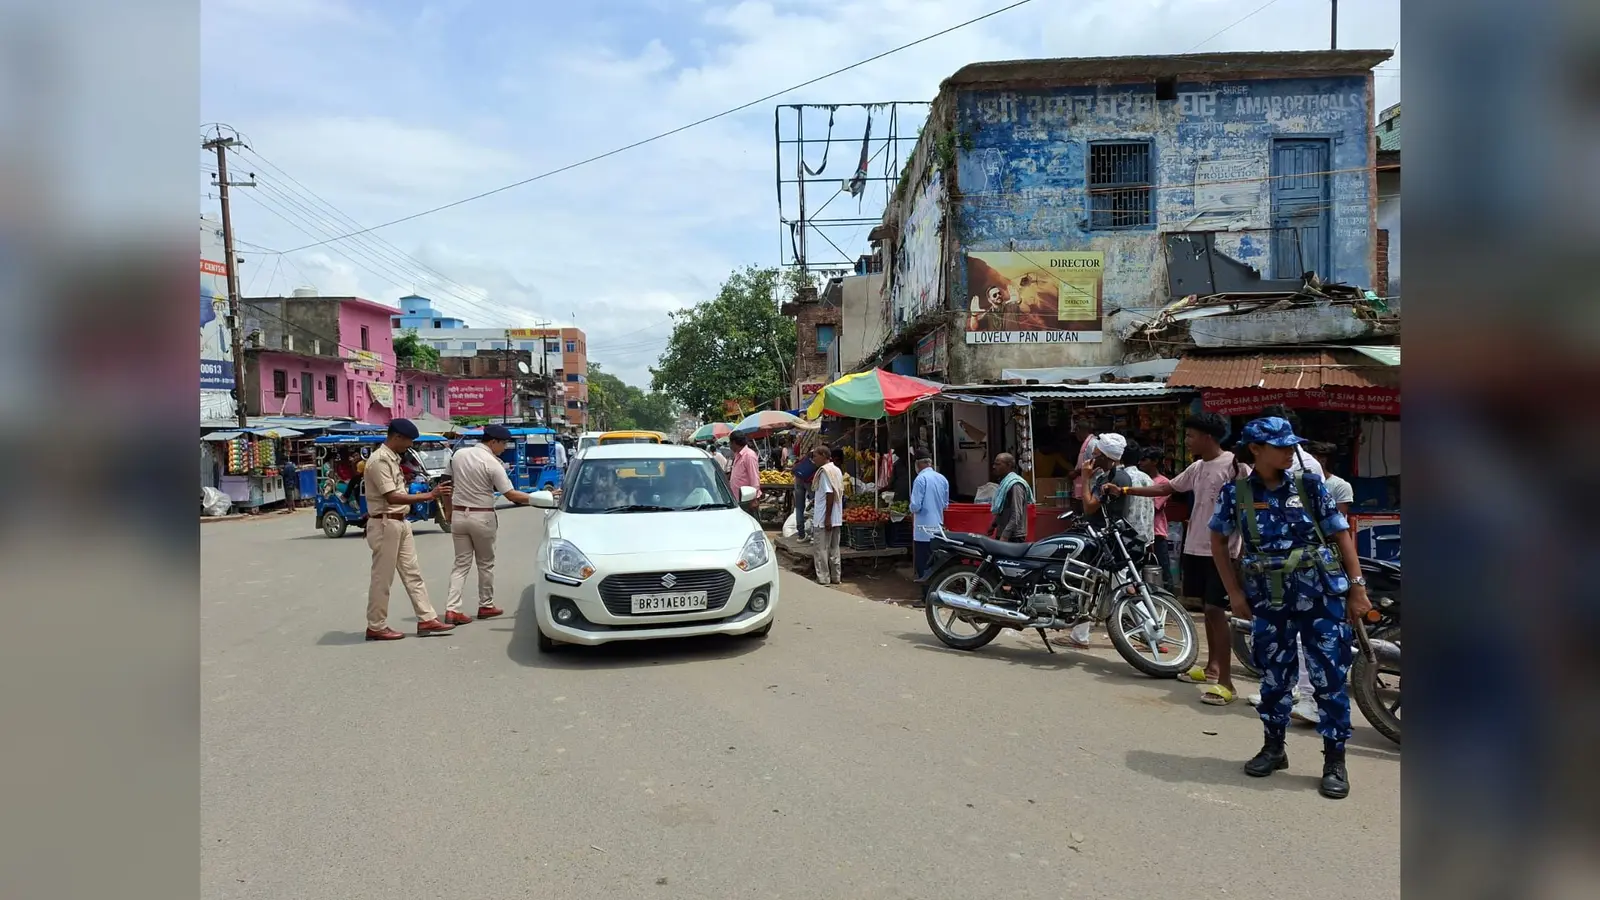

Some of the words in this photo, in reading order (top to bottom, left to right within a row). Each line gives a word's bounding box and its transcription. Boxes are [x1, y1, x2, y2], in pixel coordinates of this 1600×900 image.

[1050, 258, 1100, 268] DIRECTOR
[974, 331, 1012, 343] LOVELY
[1019, 331, 1039, 343] PAN
[1045, 331, 1079, 342] DUKAN
[1233, 395, 1251, 405] SIM
[1253, 395, 1260, 403] &
[1261, 393, 1284, 402] MNP
[1336, 393, 1355, 401] SIM
[1367, 395, 1393, 403] MNP
[639, 595, 706, 610] BR31AE8134
